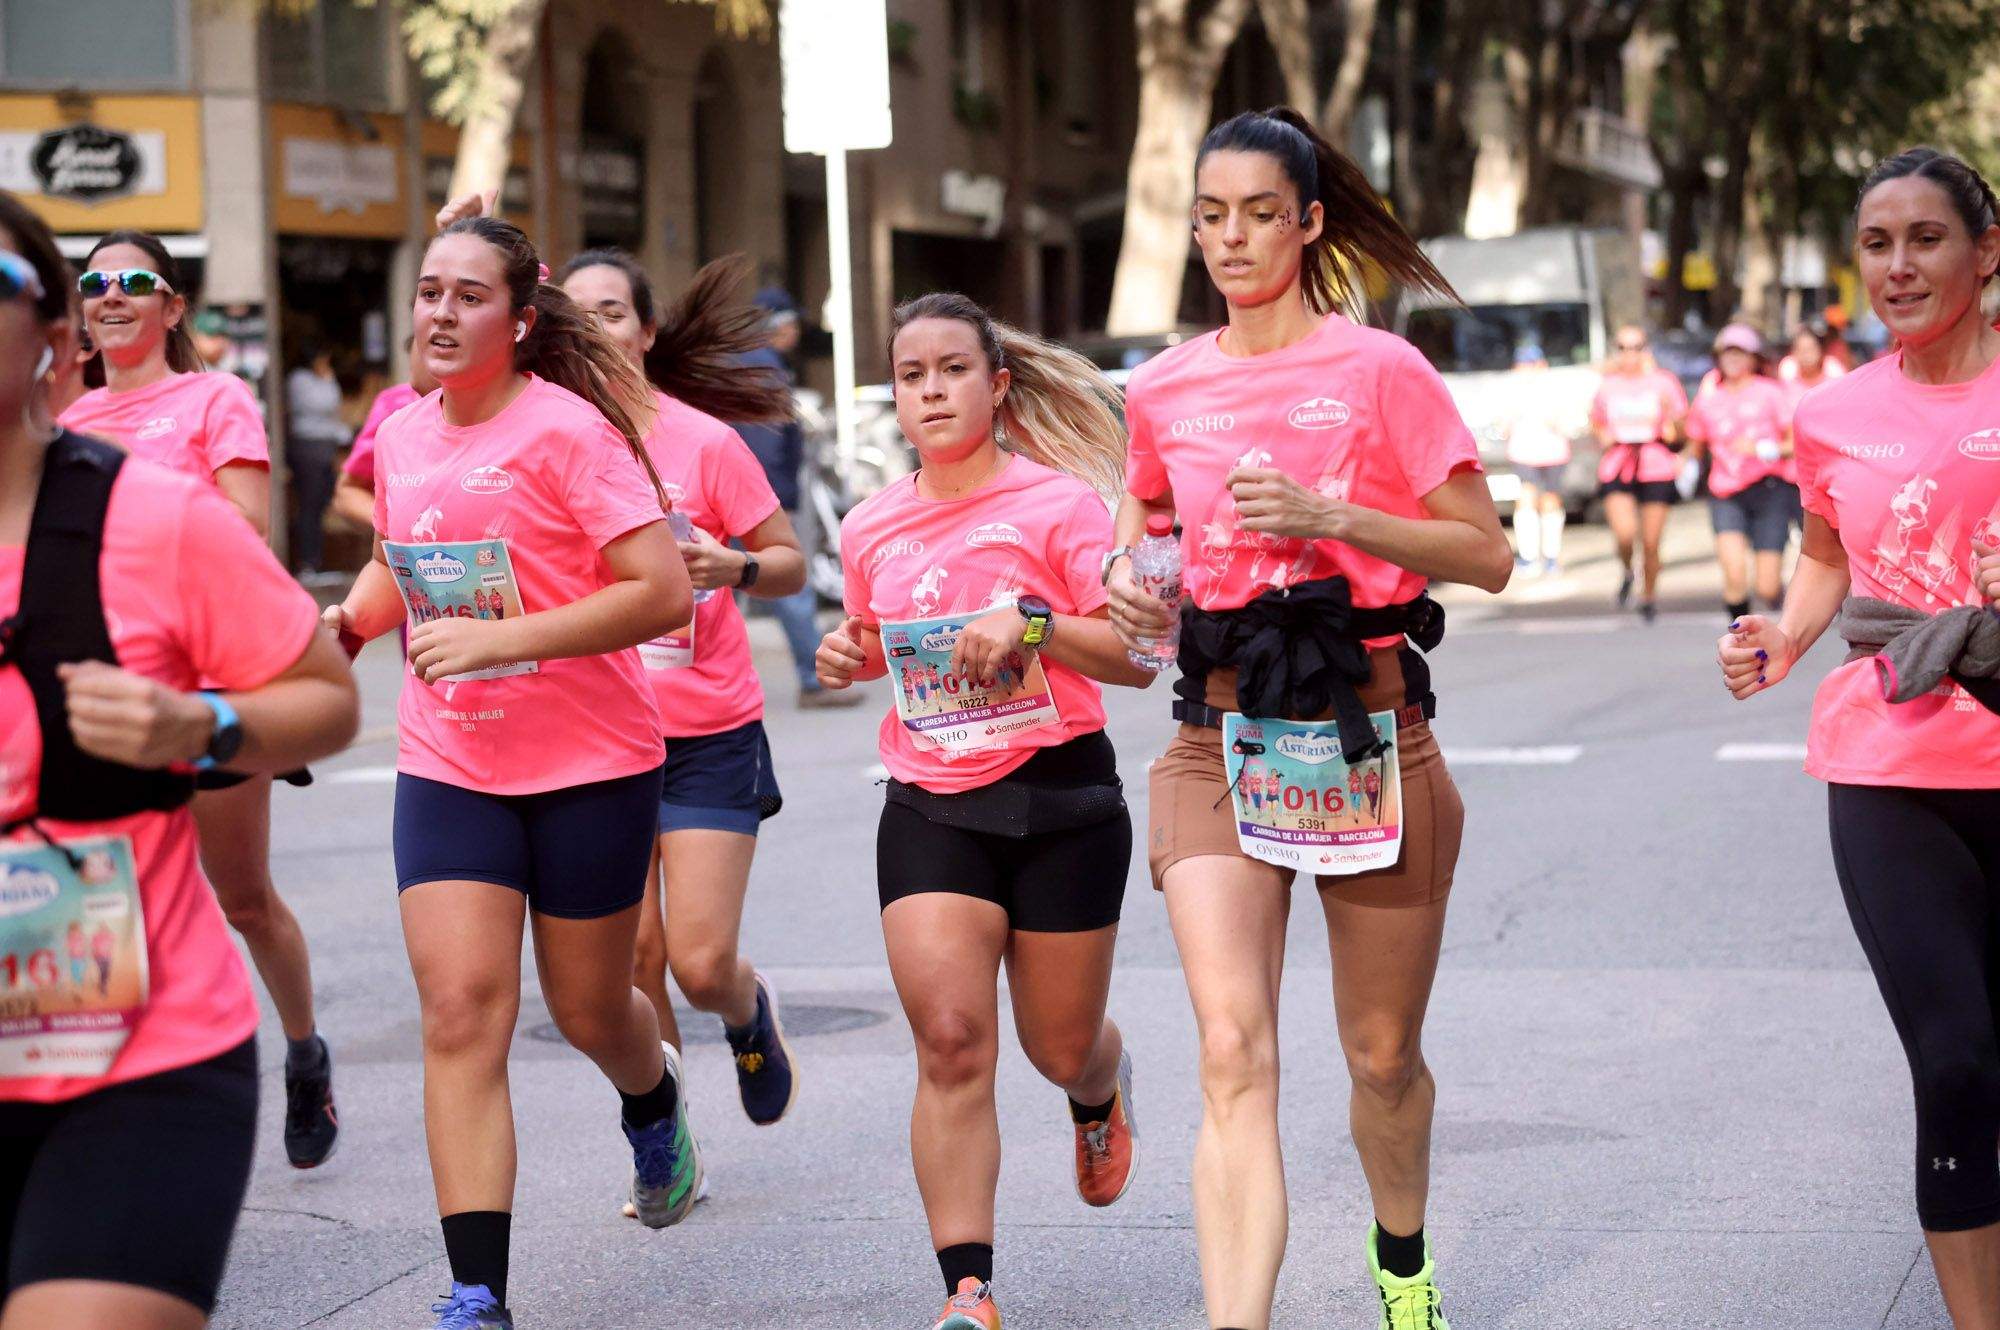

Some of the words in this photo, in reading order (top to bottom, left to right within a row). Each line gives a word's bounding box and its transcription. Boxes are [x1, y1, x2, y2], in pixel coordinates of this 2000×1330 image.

[1293, 411, 1347, 424] ASTURIANA
[1172, 413, 1236, 438] OYSHO
[1963, 439, 2000, 452] ASTUR
[463, 475, 509, 488] ASTURIANA
[926, 637, 957, 650] ASTUR
[957, 696, 989, 710] 18222
[1954, 700, 1977, 712] 2024
[479, 709, 505, 721] MUJER
[915, 715, 949, 729] CARRERA
[949, 713, 959, 724] DE
[959, 713, 969, 721] LA
[970, 708, 993, 720] MUJER
[997, 698, 1037, 715] BARCELONA
[996, 716, 1041, 734] Santander
[930, 729, 968, 744] YSHO
[1235, 729, 1264, 740] SUMA
[1280, 738, 1340, 756] ASTURIANA
[1282, 785, 1345, 813] 016
[1297, 818, 1327, 831] 5391
[1252, 827, 1282, 839] CARRERA
[1282, 830, 1293, 840] DE
[1294, 831, 1304, 841] LA
[1305, 831, 1332, 842] MUJER
[1338, 830, 1386, 842] BARCELONA
[1256, 843, 1301, 863] OYSHO
[1333, 850, 1384, 864] Santander
[0, 947, 60, 988] 16
